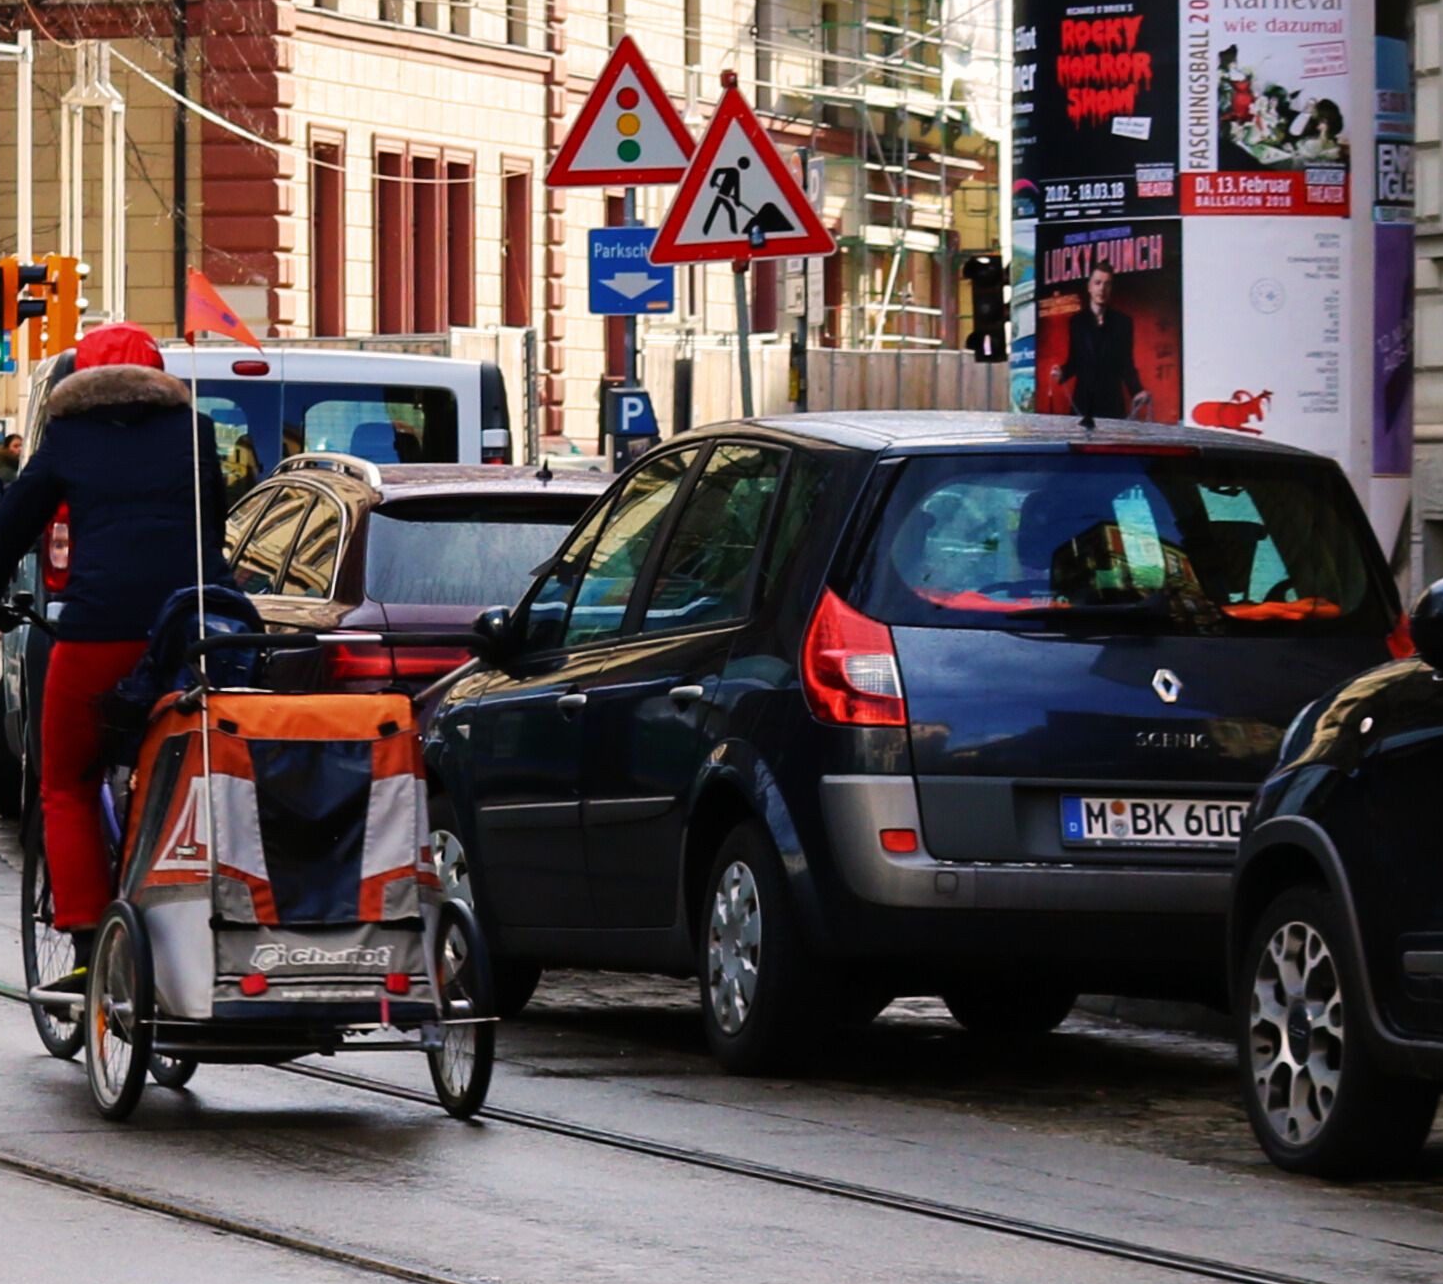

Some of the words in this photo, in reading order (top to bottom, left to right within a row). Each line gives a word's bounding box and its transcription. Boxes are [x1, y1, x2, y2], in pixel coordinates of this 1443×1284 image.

[1061, 15, 1144, 54] ROCKY
[1224, 17, 1257, 33] wie
[1265, 17, 1343, 34] dazumal
[1057, 51, 1154, 92] HORROR
[1067, 84, 1139, 129] SHOW
[1188, 29, 1209, 169] FASCHINGSBALL
[1239, 176, 1292, 194] Februar
[1044, 243, 1093, 285] LUCKY
[1096, 233, 1163, 274] PUNCH
[621, 396, 644, 431] P
[1135, 731, 1210, 749] SCENIC
[1085, 802, 1108, 835] M
[1130, 803, 1176, 836] BK
